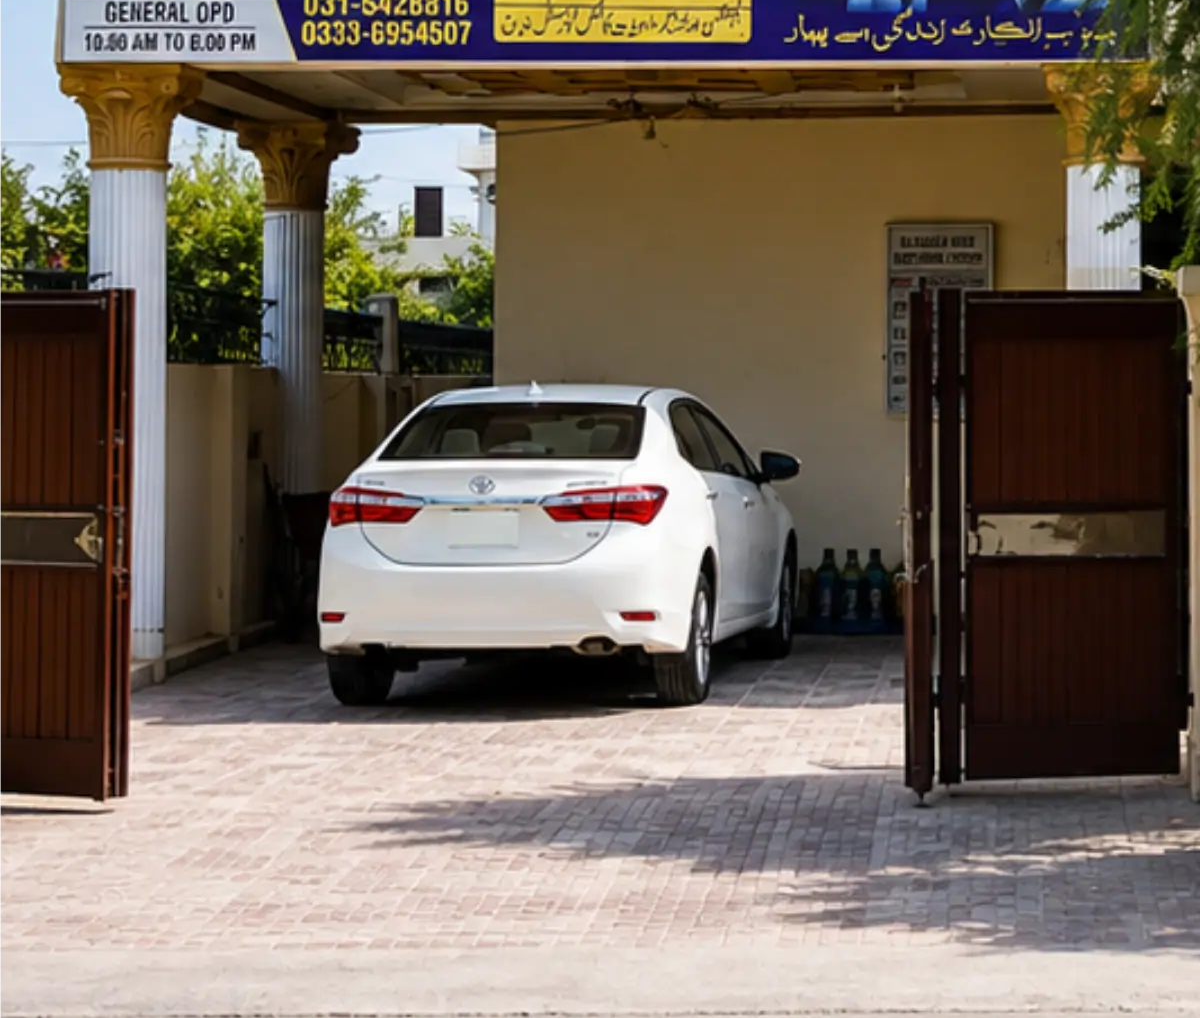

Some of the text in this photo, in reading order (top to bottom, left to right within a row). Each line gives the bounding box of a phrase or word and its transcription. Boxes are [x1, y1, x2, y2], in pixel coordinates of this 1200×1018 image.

[104, 0, 236, 24] GENERAL OPD
[132, 33, 159, 52] AM
[164, 33, 185, 52] TO
[230, 33, 257, 52] PM
[301, 19, 472, 46] 0333-6954507
